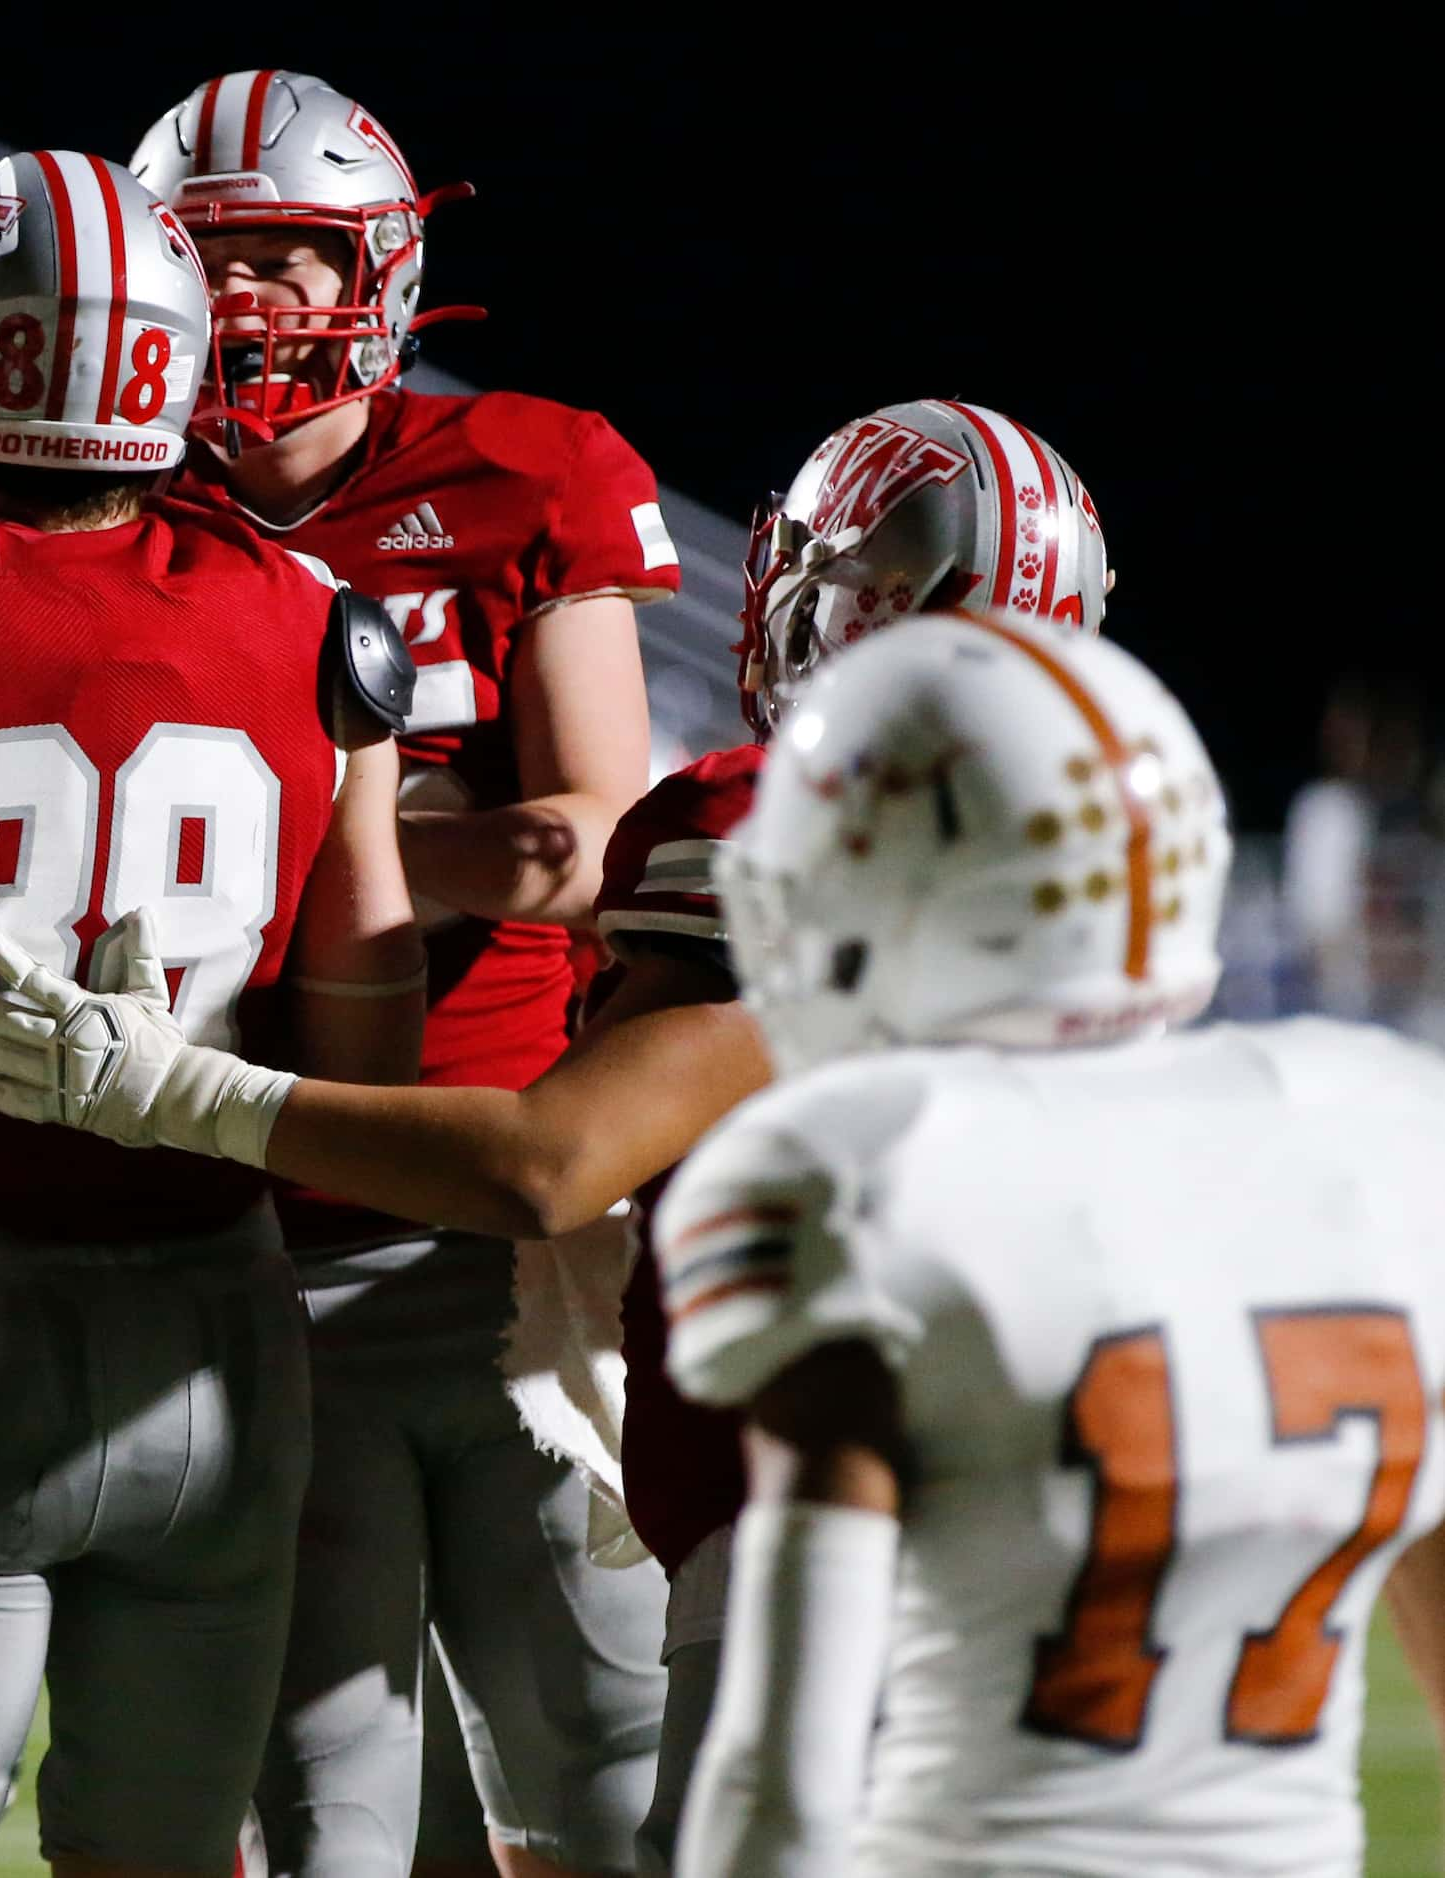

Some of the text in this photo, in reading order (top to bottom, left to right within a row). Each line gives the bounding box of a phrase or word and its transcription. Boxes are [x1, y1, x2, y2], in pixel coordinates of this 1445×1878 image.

[119, 328, 171, 425] 8
[807, 415, 972, 544] W
[376, 532, 454, 550] adidas
[1018, 1300, 1428, 1756] 17
